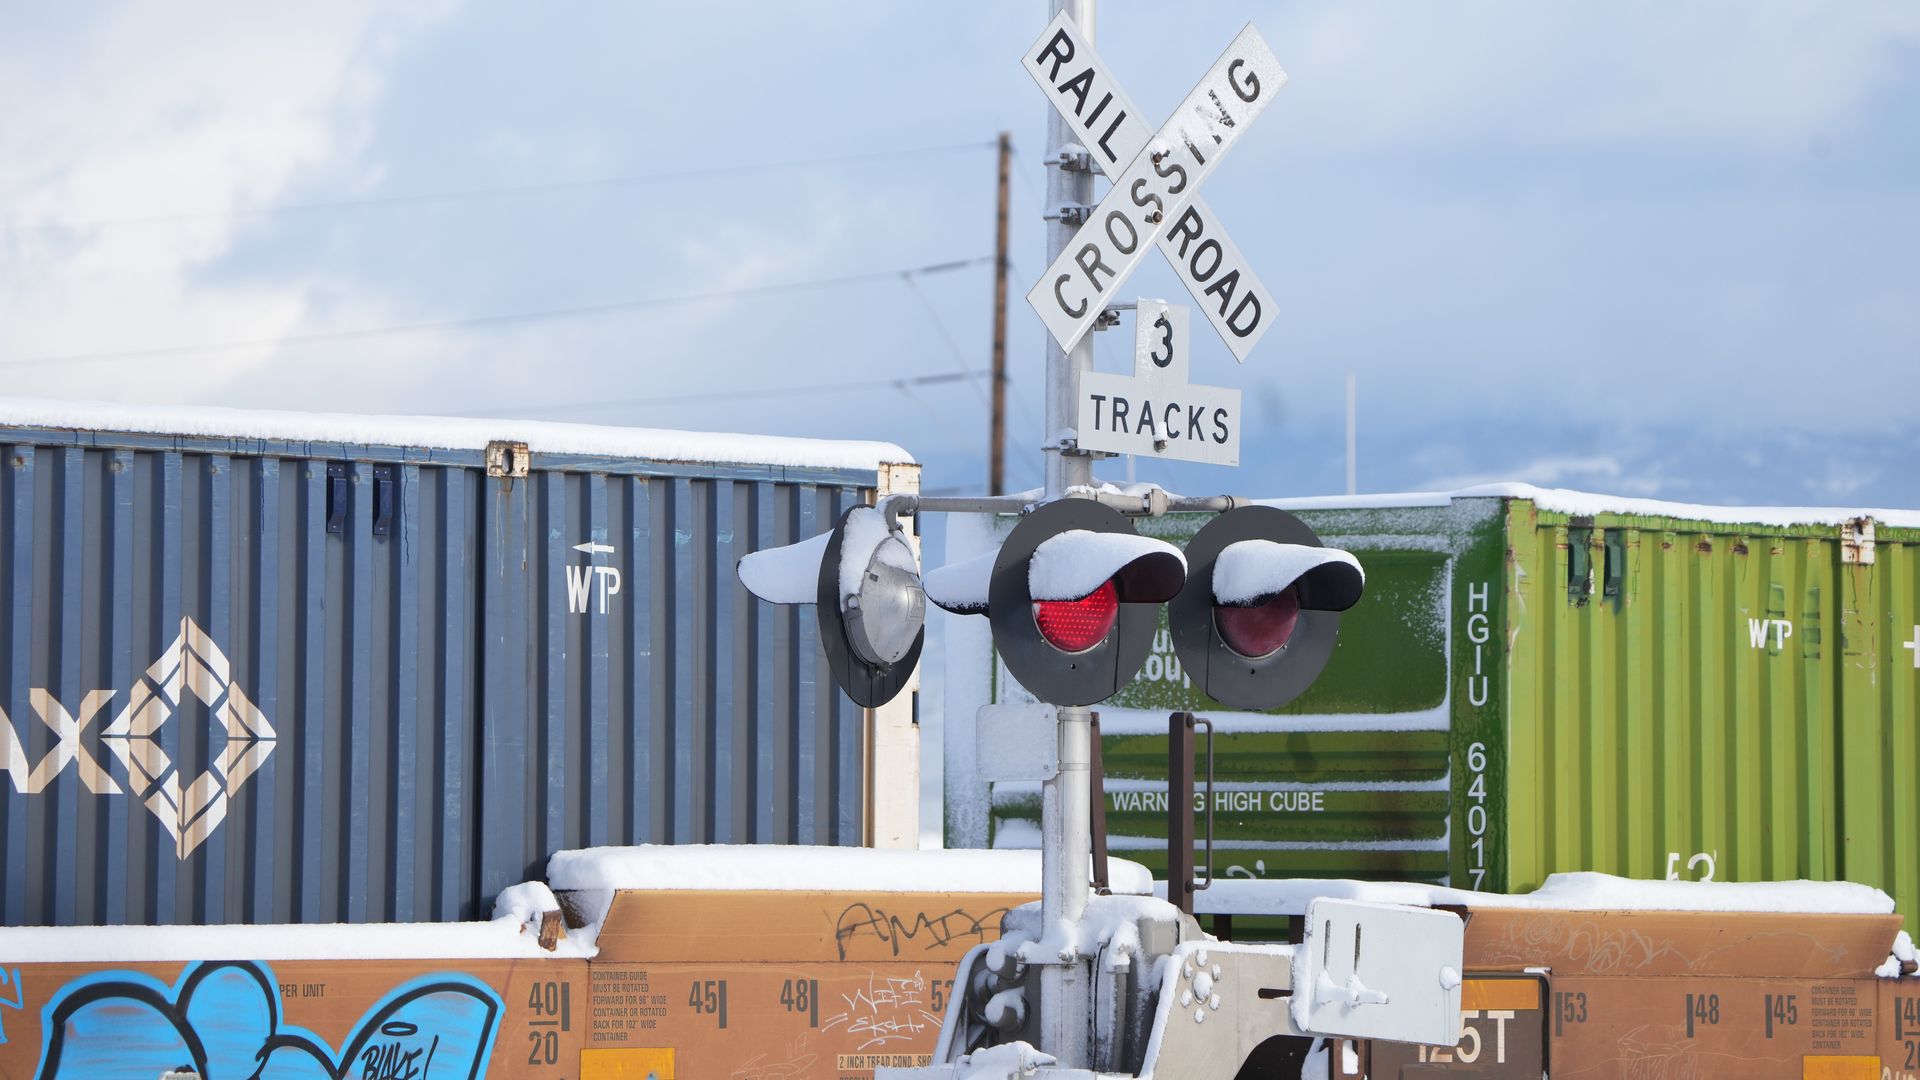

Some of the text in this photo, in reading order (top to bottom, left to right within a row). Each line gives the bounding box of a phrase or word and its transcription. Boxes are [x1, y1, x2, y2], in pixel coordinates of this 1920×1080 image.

[1036, 28, 1262, 338] RAIL ROAD
[1054, 58, 1261, 319] CROSSING
[1150, 317, 1174, 368] 3
[1090, 394, 1229, 444] TRACKS
[566, 565, 621, 614] WP
[1467, 582, 1490, 707] HGIU
[1748, 618, 1793, 650] WP
[0, 688, 124, 794] X
[1112, 792, 1325, 811] WARNG HIGH CUBE
[279, 983, 326, 998] PER UNIT
[592, 971, 648, 980] CONTAINER GUIDE
[592, 983, 649, 993] MUST BE ROTATED
[1811, 986, 1840, 995] CONTAINER
[528, 981, 559, 1016] 40
[593, 996, 624, 1005] FORWARD
[625, 996, 638, 1004] FOR
[651, 995, 667, 1005] WIDE
[688, 980, 717, 1014] 45
[780, 979, 808, 1012] 48
[1564, 992, 1587, 1023] 53
[1695, 993, 1720, 1025] 48
[1774, 994, 1798, 1025] 45
[1835, 997, 1857, 1006] ROTATED
[593, 1007, 667, 1017] CONTAINER OR ROTATED
[593, 1020, 610, 1029] BACK
[611, 1020, 624, 1029] FOR
[640, 1019, 657, 1029] WIDE
[1812, 1019, 1840, 1028] CONTAINER
[1904, 997, 1920, 1027] 4
[528, 1031, 559, 1065] 20
[593, 1031, 628, 1041] CONTAINER
[1812, 1040, 1841, 1049] CONTAINER
[839, 1056, 844, 1069] 2
[846, 1056, 865, 1069] INCH
[867, 1055, 891, 1069] TREAD
[892, 1056, 915, 1068] COND.
[1904, 1040, 1920, 1070] 2
